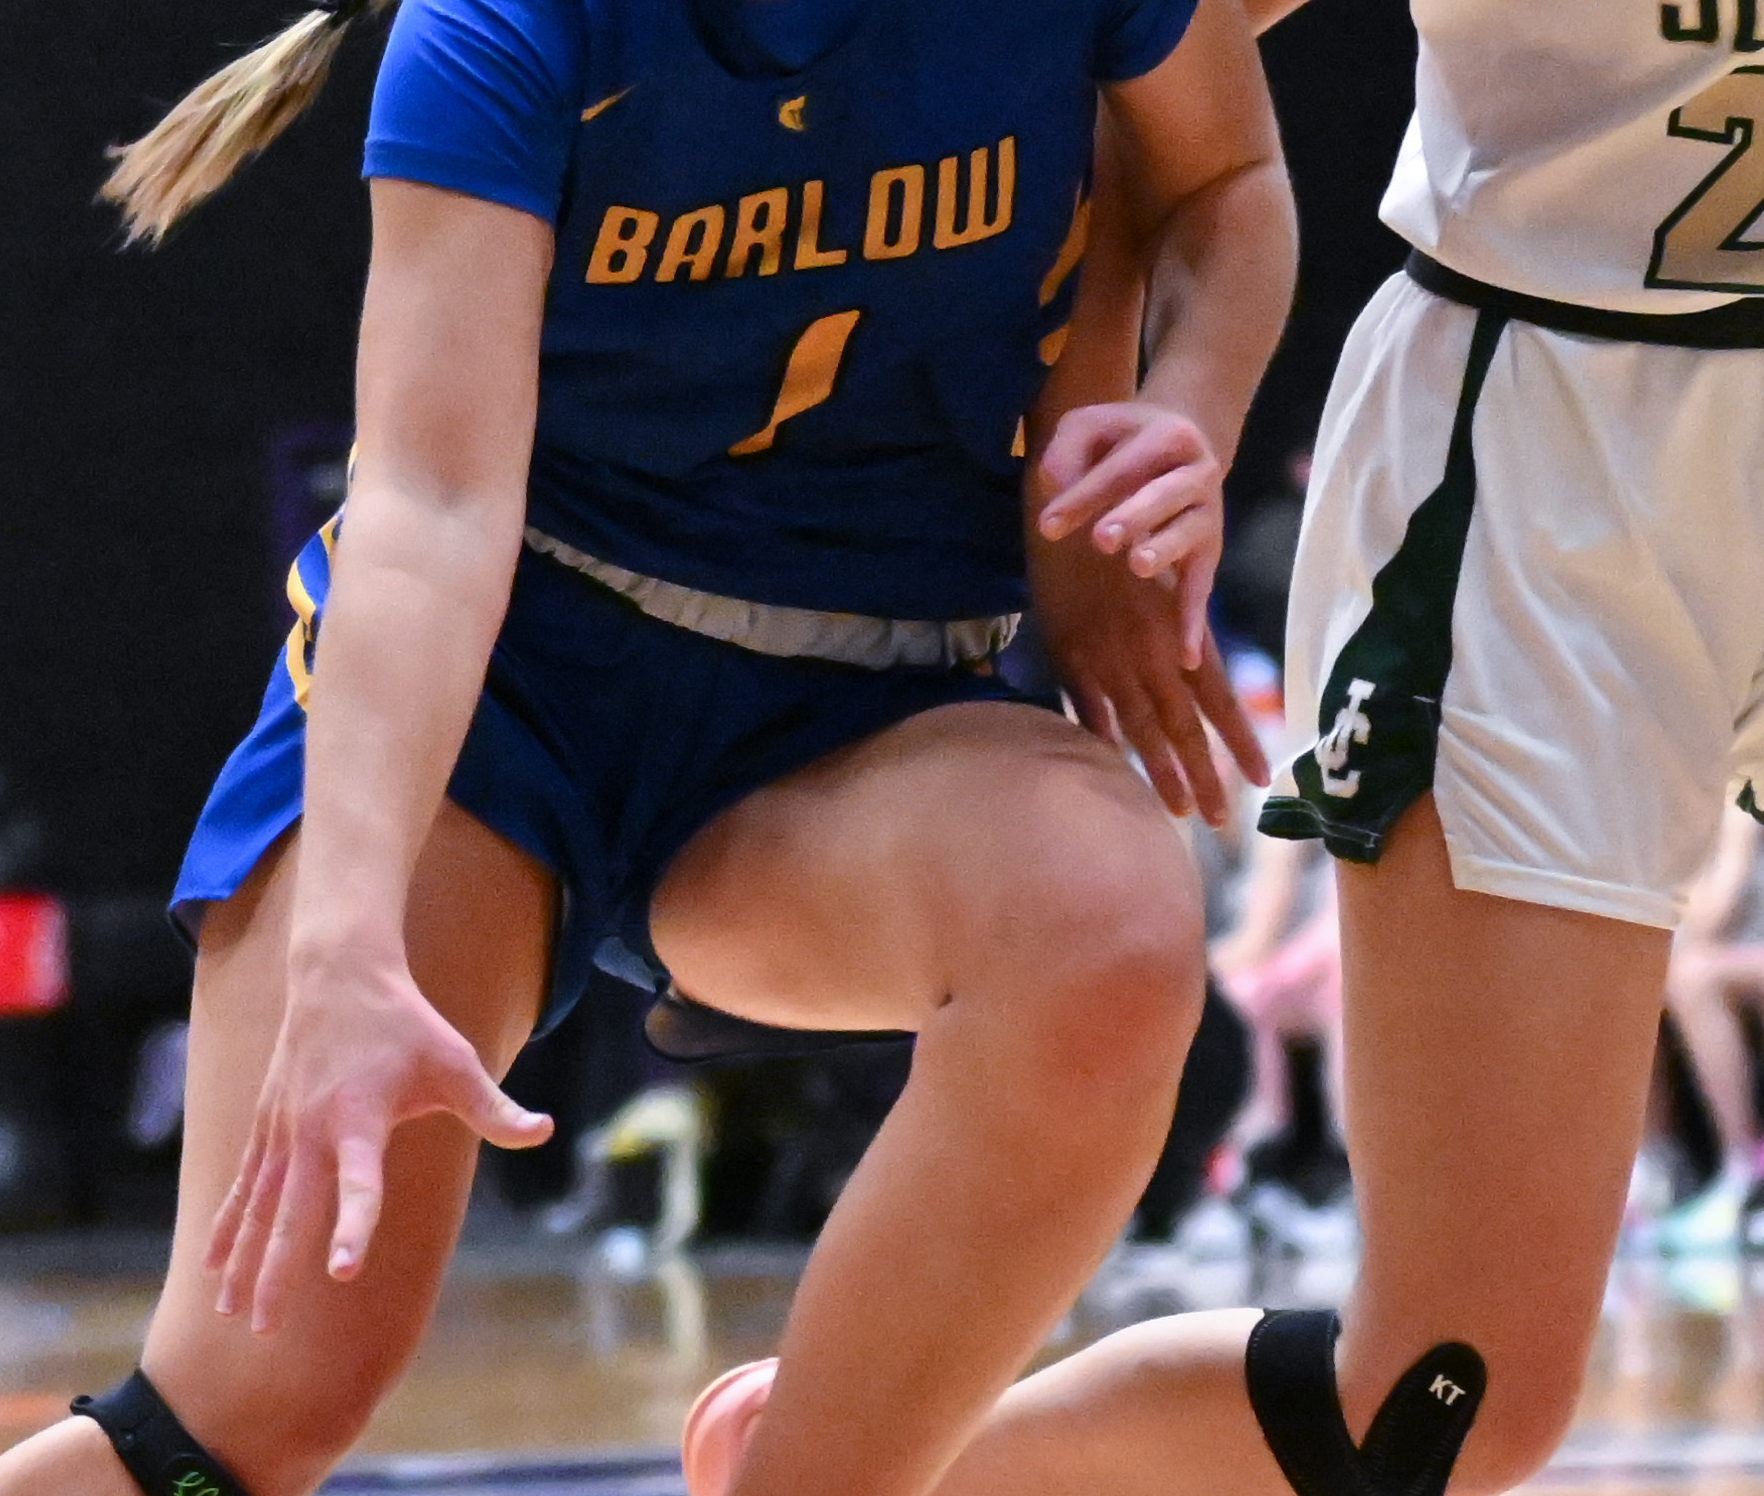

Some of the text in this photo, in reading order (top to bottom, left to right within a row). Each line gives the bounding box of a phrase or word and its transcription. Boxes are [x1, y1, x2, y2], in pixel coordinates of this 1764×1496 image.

[584, 134, 1016, 285] BARLOW
[728, 309, 861, 457] 1
[1428, 1373, 1467, 1406] KT
